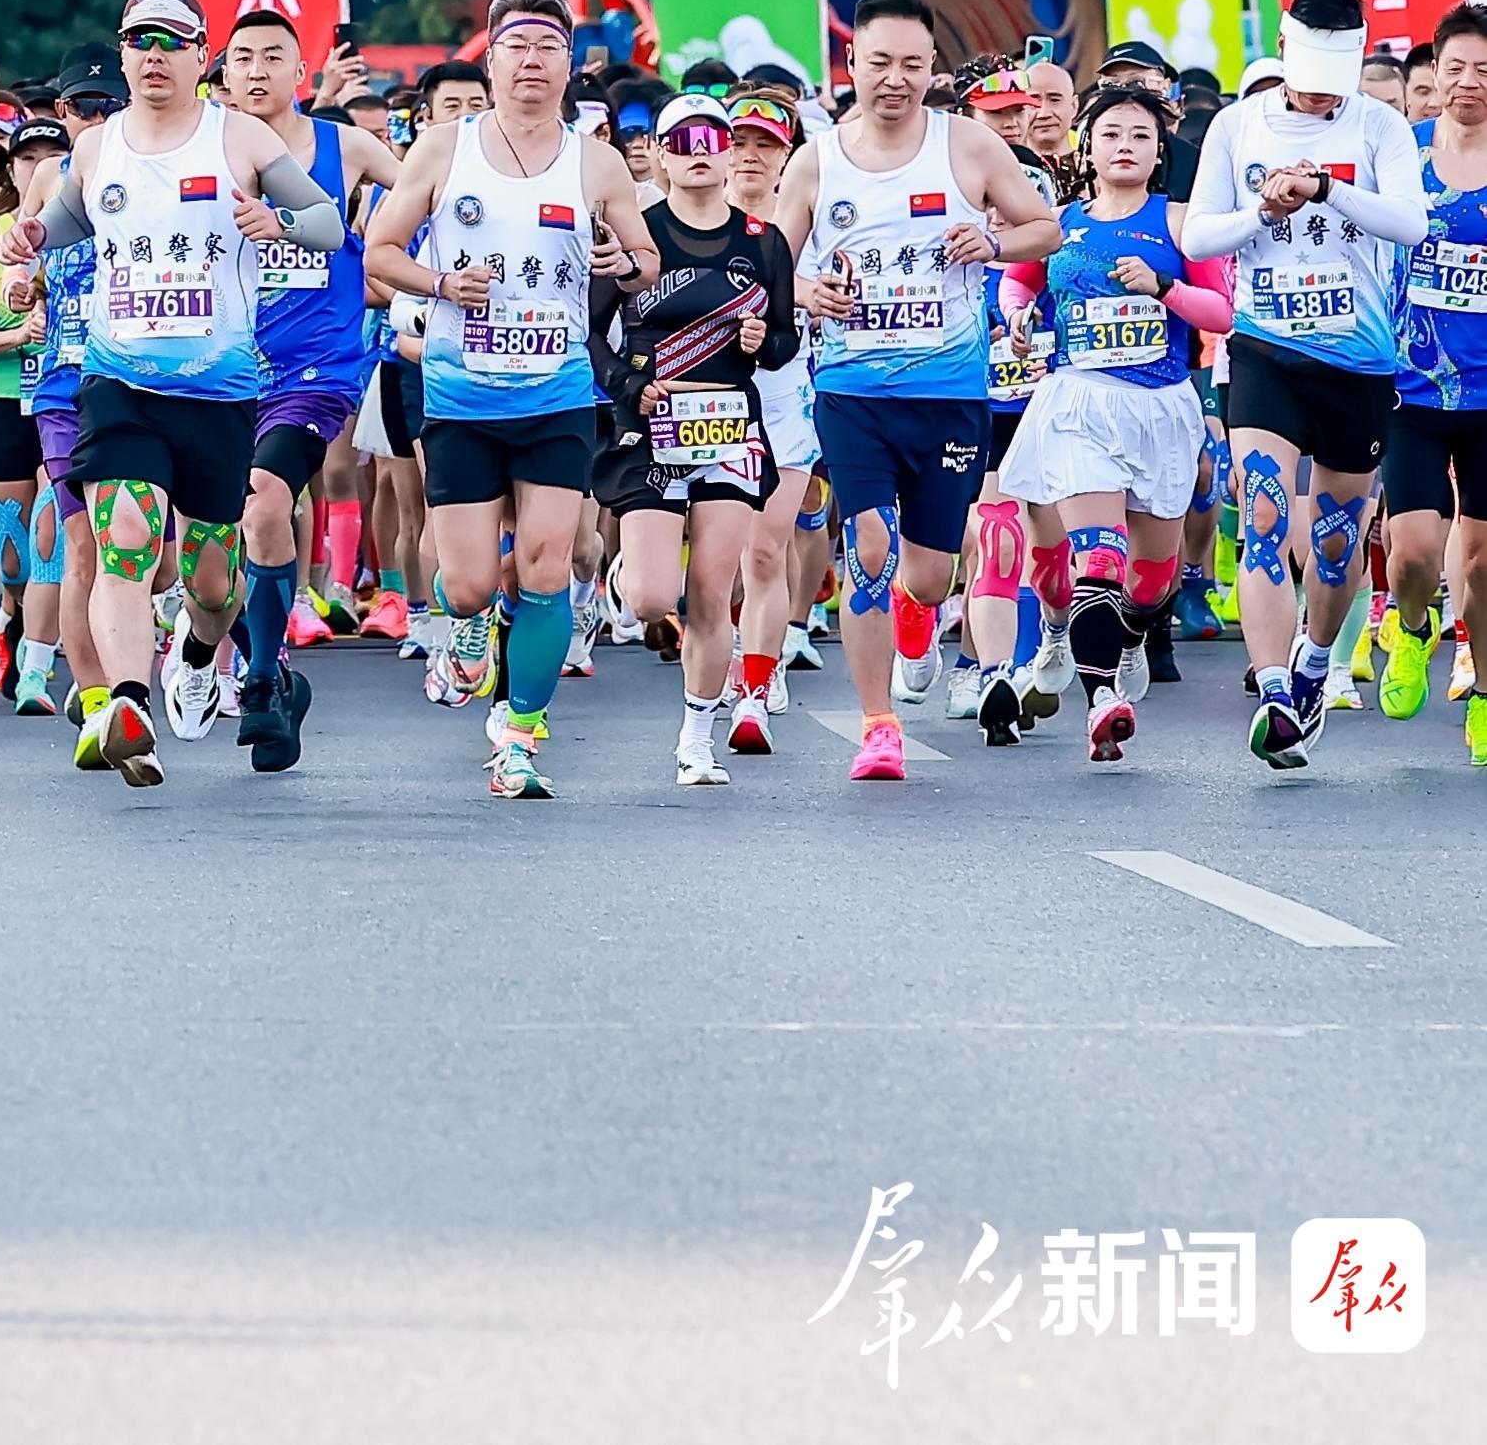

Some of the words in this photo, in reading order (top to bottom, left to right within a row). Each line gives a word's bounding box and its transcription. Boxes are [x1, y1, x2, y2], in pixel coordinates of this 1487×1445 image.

[1252, 213, 1365, 250] 國警察
[102, 232, 228, 269] 中國警察
[132, 289, 207, 318] 57611
[867, 302, 941, 330] 57454
[1277, 289, 1353, 320] 13813
[491, 328, 566, 354] 58078
[1092, 321, 1166, 349] 31672
[679, 418, 745, 446] 60664
